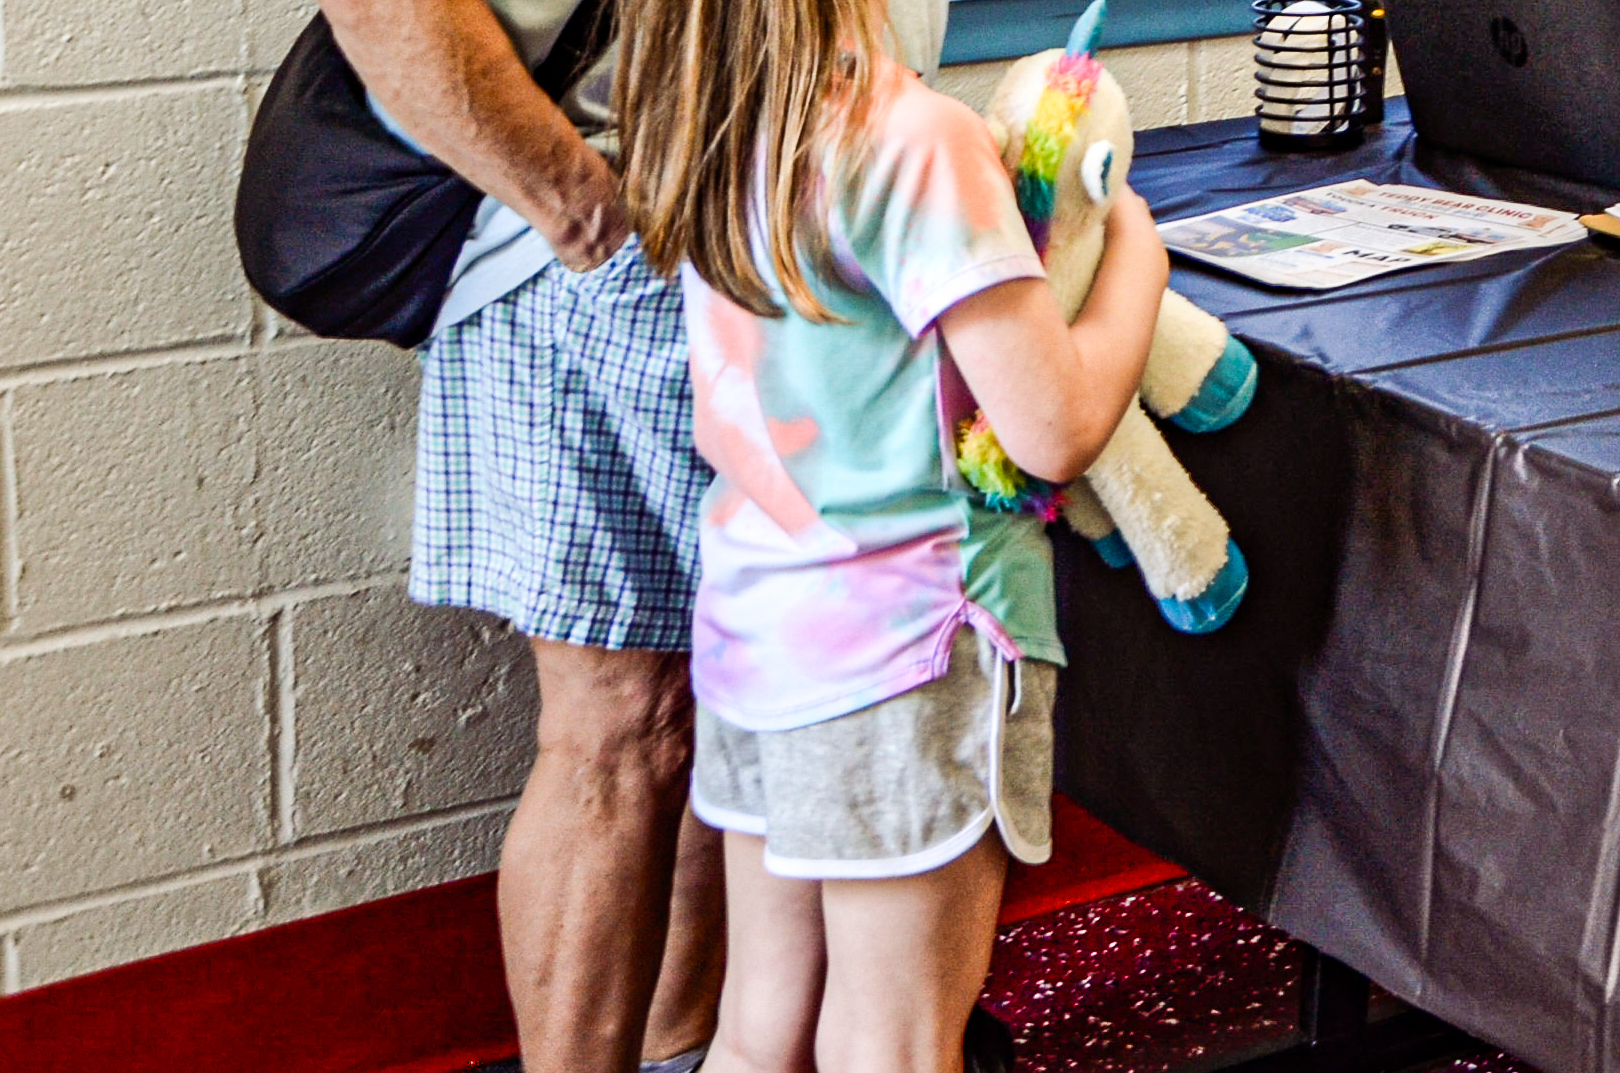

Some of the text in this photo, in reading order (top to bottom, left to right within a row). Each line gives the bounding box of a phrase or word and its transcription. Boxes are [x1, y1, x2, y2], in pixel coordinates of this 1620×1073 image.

[1378, 191, 1432, 204] TEDDY
[1431, 198, 1475, 210] BEAR
[1476, 205, 1533, 220] CLINIC
[1380, 205, 1440, 220] TRUCK
[1342, 249, 1412, 263] MAP
